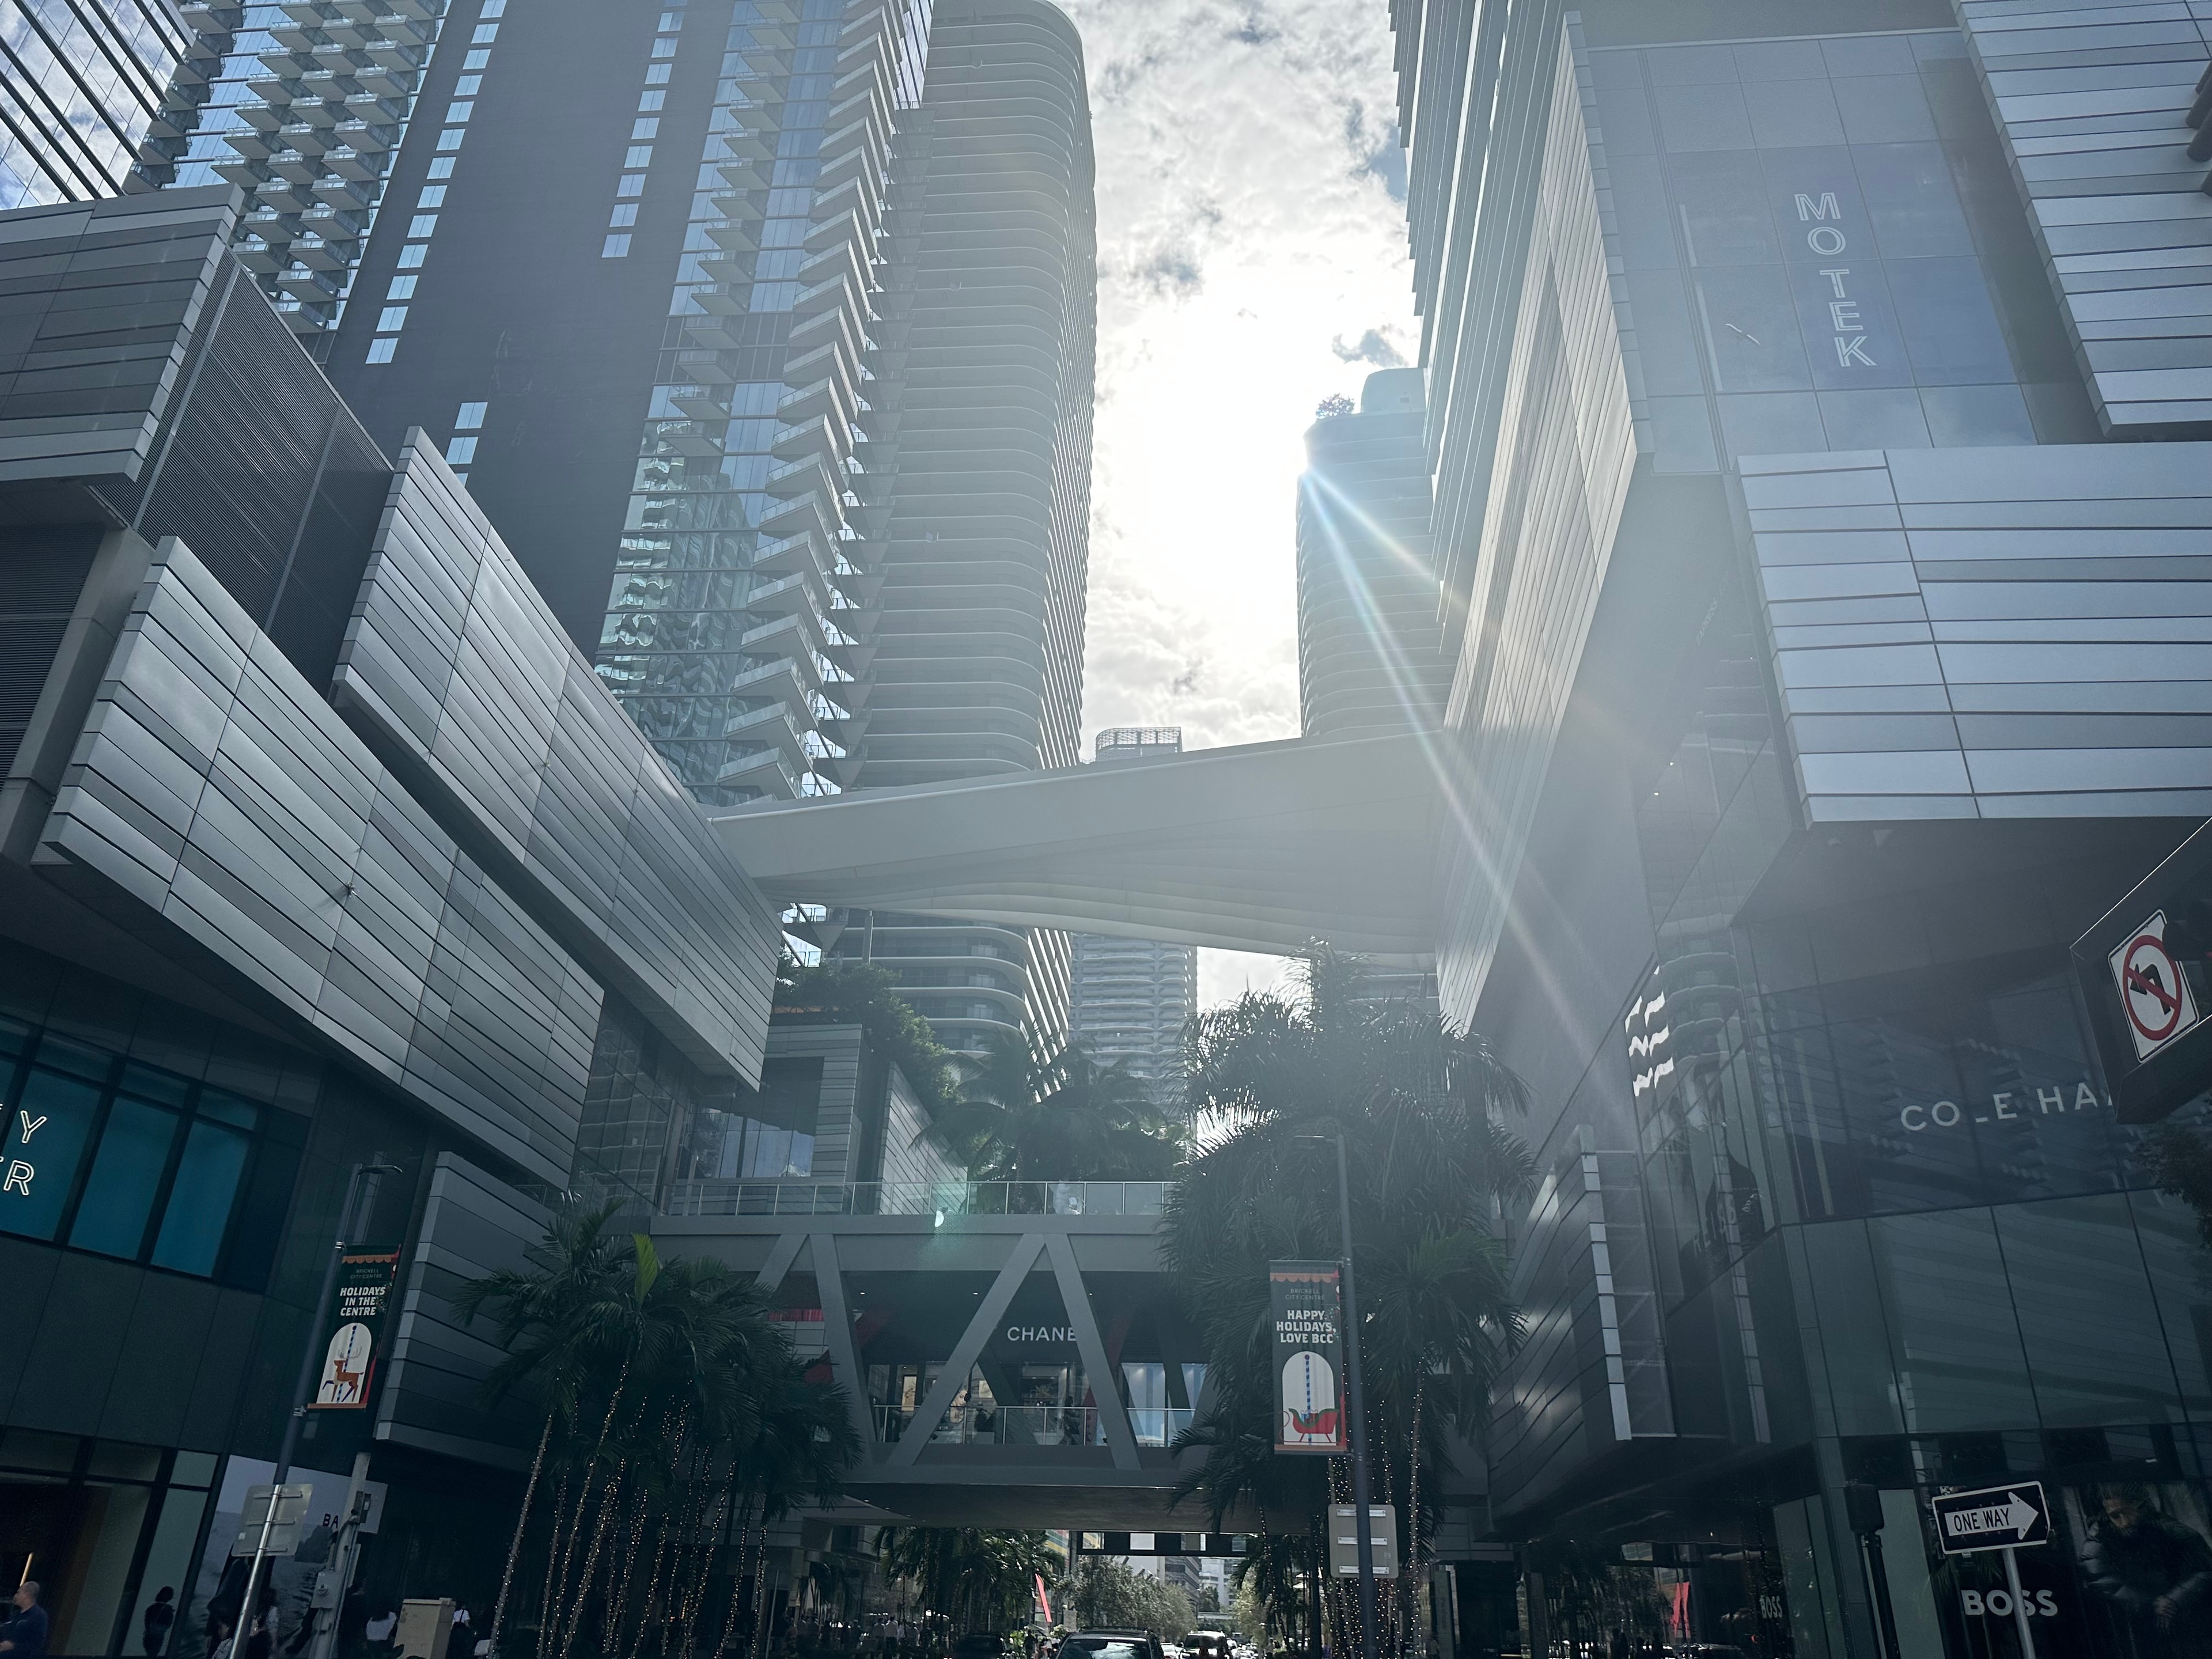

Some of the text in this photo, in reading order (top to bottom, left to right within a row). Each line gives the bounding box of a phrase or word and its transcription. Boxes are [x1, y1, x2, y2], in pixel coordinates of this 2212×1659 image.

[1794, 192, 1877, 368] MOTEK
[1901, 1082, 2113, 1131] COE HA
[0, 1156, 35, 1196] R
[340, 1286, 386, 1296] HOLIDAYS
[345, 1296, 377, 1306] IN THE
[340, 1306, 377, 1316] CENTRE
[1007, 1326, 1077, 1342] CHANE
[1276, 1321, 1336, 1333] HOLIDAYS,
[1280, 1332, 1334, 1344] LOVE BCC
[322, 1513, 339, 1529] BA
[1953, 1507, 2010, 1532] ONE WAY
[1960, 1589, 2058, 1617] BOSS
